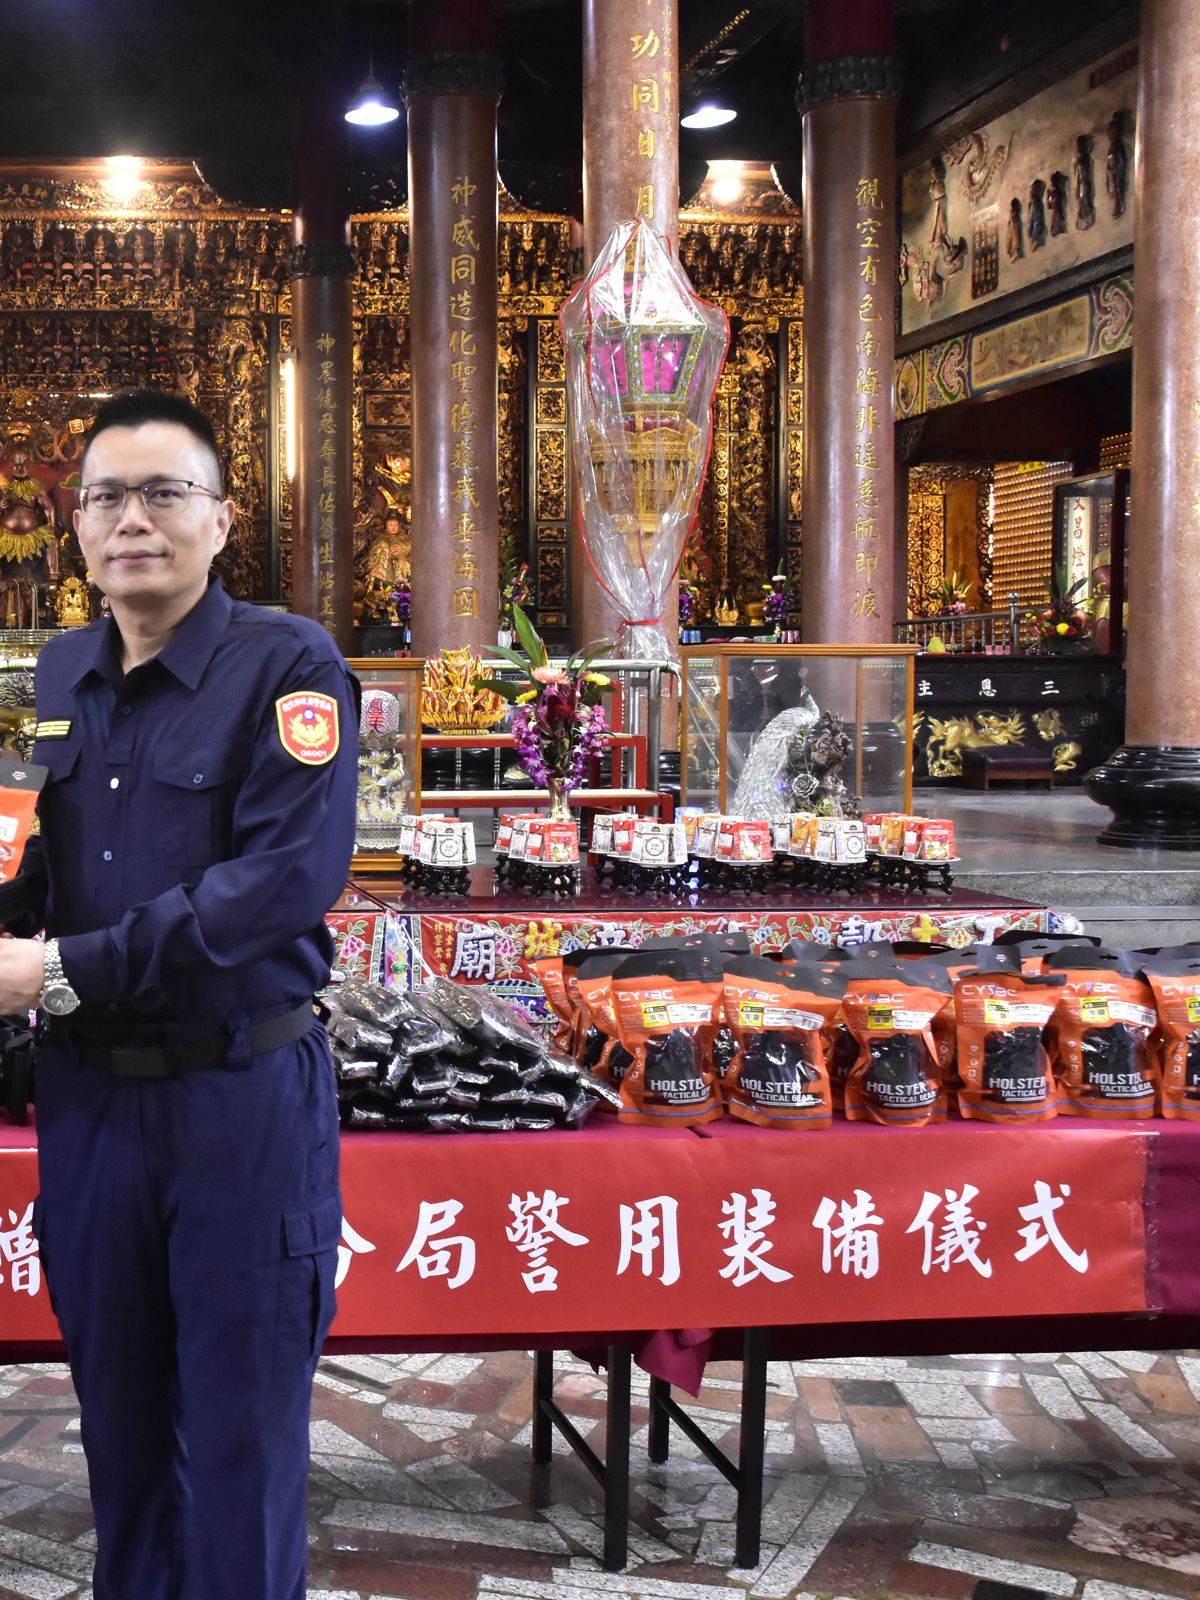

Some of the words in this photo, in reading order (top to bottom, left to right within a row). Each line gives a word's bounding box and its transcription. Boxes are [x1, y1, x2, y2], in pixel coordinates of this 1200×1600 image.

[630, 0, 660, 220] 功同日月
[917, 678, 1060, 698] 三恩主
[740, 1077, 802, 1095] HOLSTER
[866, 1081, 928, 1096] HOLSTER
[663, 1090, 701, 1100] TACTICAL
[751, 1091, 789, 1102] TACTICAL
[879, 1095, 919, 1104] TACTICAL
[1001, 1089, 1037, 1097] TACTICAL
